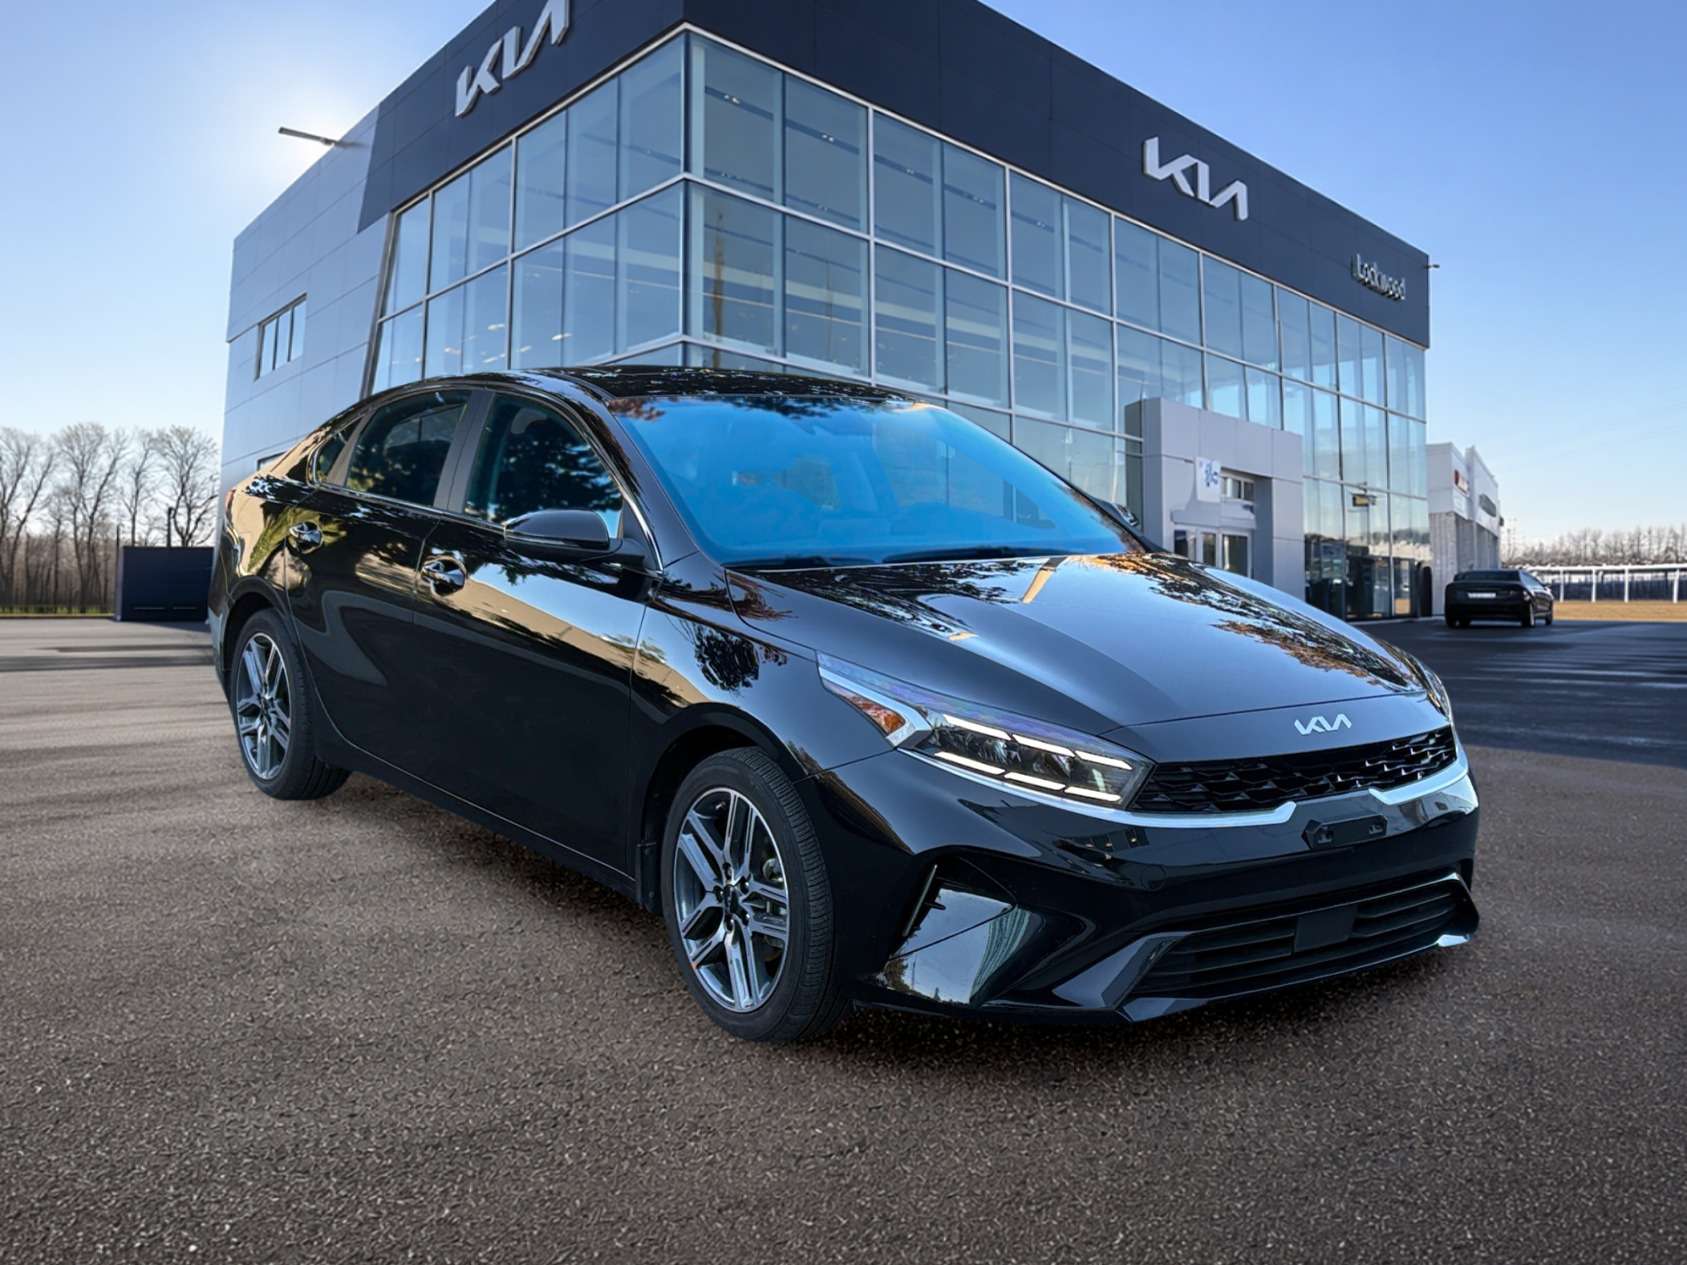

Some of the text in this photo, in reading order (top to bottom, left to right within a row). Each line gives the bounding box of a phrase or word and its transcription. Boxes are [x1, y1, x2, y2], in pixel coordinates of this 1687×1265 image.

[455, 0, 570, 117] KIA
[1143, 136, 1248, 221] KIA
[1294, 713, 1352, 735] KIA
